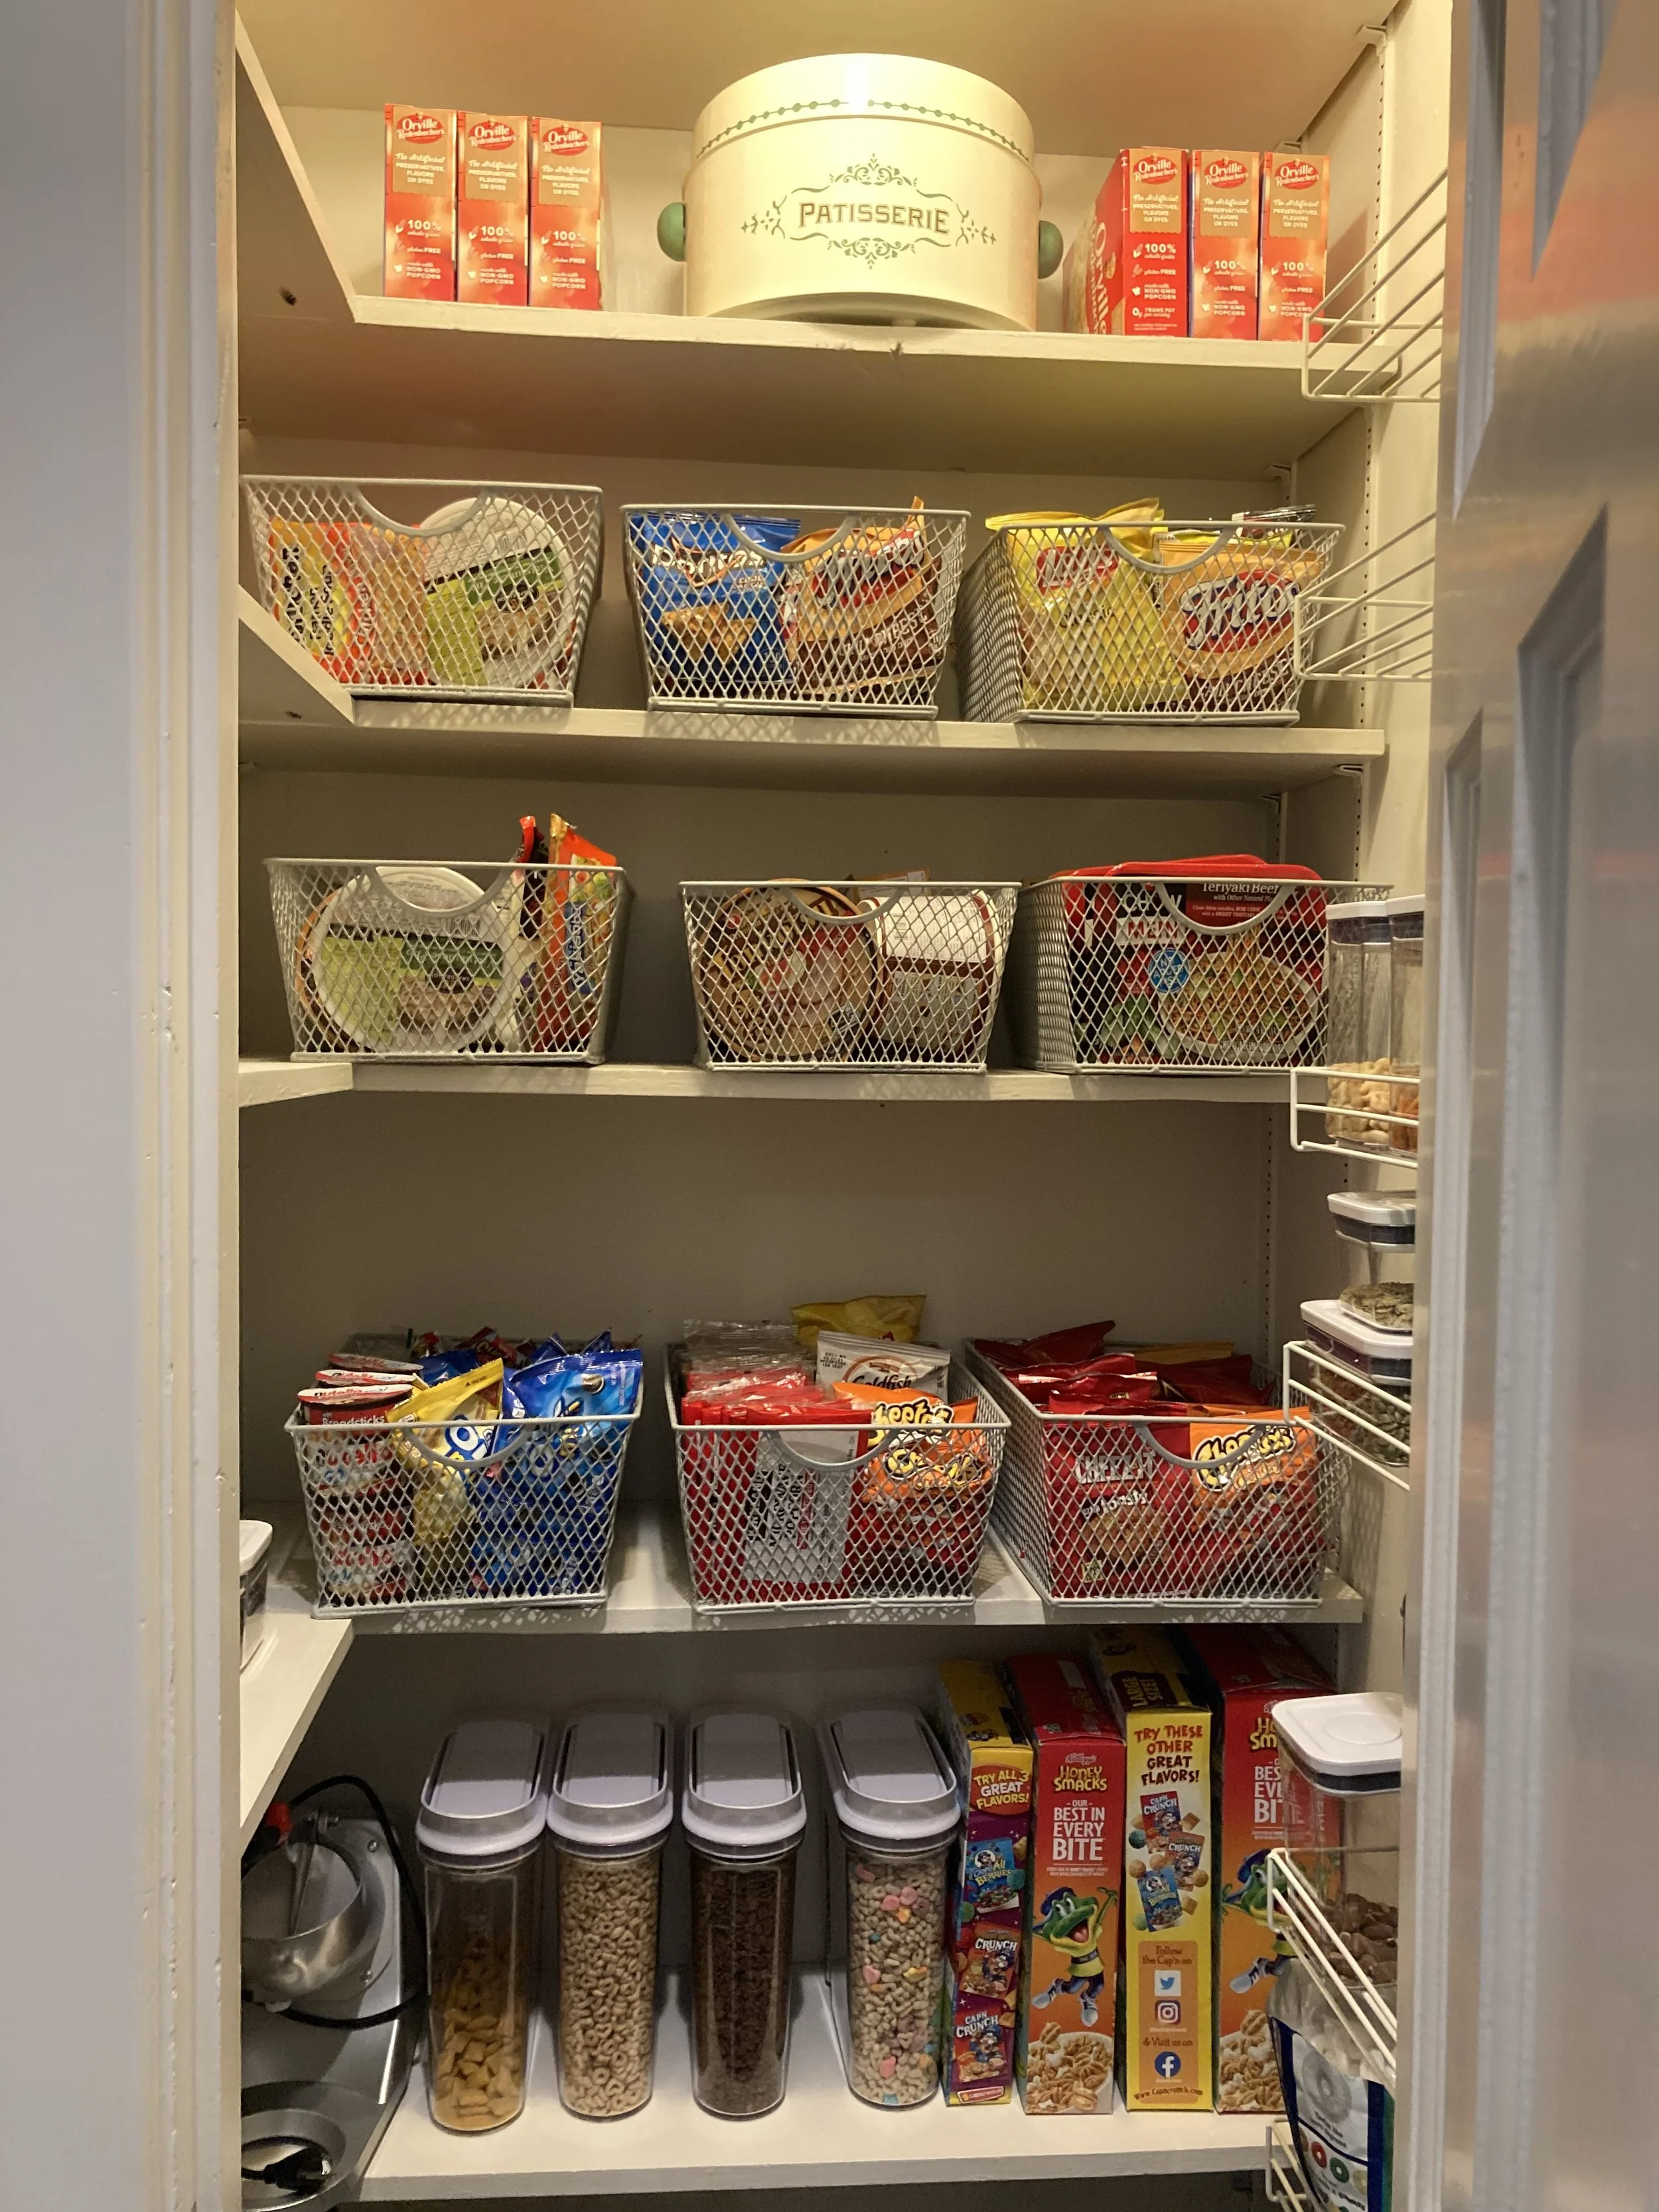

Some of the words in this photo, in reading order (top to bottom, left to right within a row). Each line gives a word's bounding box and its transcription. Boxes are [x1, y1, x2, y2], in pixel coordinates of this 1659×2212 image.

[402, 118, 438, 131] Orville
[474, 125, 510, 138] Orville
[548, 130, 583, 143] Orville
[1138, 159, 1172, 173] Orville
[1209, 163, 1243, 177] Orville
[1279, 165, 1313, 178] Orville
[407, 219, 441, 231] 100%
[798, 202, 950, 235] PATISSERIE
[480, 226, 514, 237] 100%
[553, 230, 586, 241] 100%
[1145, 243, 1177, 254] 100%
[1214, 260, 1246, 270] 100%
[1282, 261, 1314, 272] 100%
[1203, 883, 1250, 894] Teriyaki
[1252, 883, 1279, 894] Beef
[1121, 893, 1182, 912] CHW
[1128, 921, 1177, 939] MEIN
[323, 1415, 385, 1425] Breadsticks
[1121, 1676, 1148, 1707] LARGE
[1134, 1728, 1161, 1743] TRY
[1165, 1725, 1203, 1739] THESE
[1147, 1739, 1193, 1755] OTHER
[1147, 1755, 1192, 1770] GREAT
[973, 1773, 995, 1787] TRY
[998, 1770, 1017, 1782] ALL
[1018, 1769, 1030, 1783] 3
[1060, 1766, 1103, 1780] HONEY
[1141, 1769, 1200, 1786] FLAVORS!
[1255, 1766, 1281, 1781] BES
[981, 1781, 1023, 1797] GREAT
[1054, 1777, 1108, 1791] SMACKS
[976, 1793, 1029, 1810] FLAVORS!
[1144, 1799, 1177, 1814] CRUNCH
[1054, 1807, 1088, 1821] BEST
[1091, 1807, 1105, 1820] IN
[1053, 1822, 1105, 1838] EVERY
[1052, 1838, 1104, 1861] BITE
[1169, 1843, 1201, 1852] CRUNCH
[975, 1938, 1017, 1952] CRUNCH
[1155, 1945, 1183, 1955] Follow
[1142, 1956, 1156, 1965] the
[1157, 1955, 1180, 1967] Cap'n
[956, 2015, 999, 2038] CRUNCH
[1151, 2037, 1170, 2047] Visit
